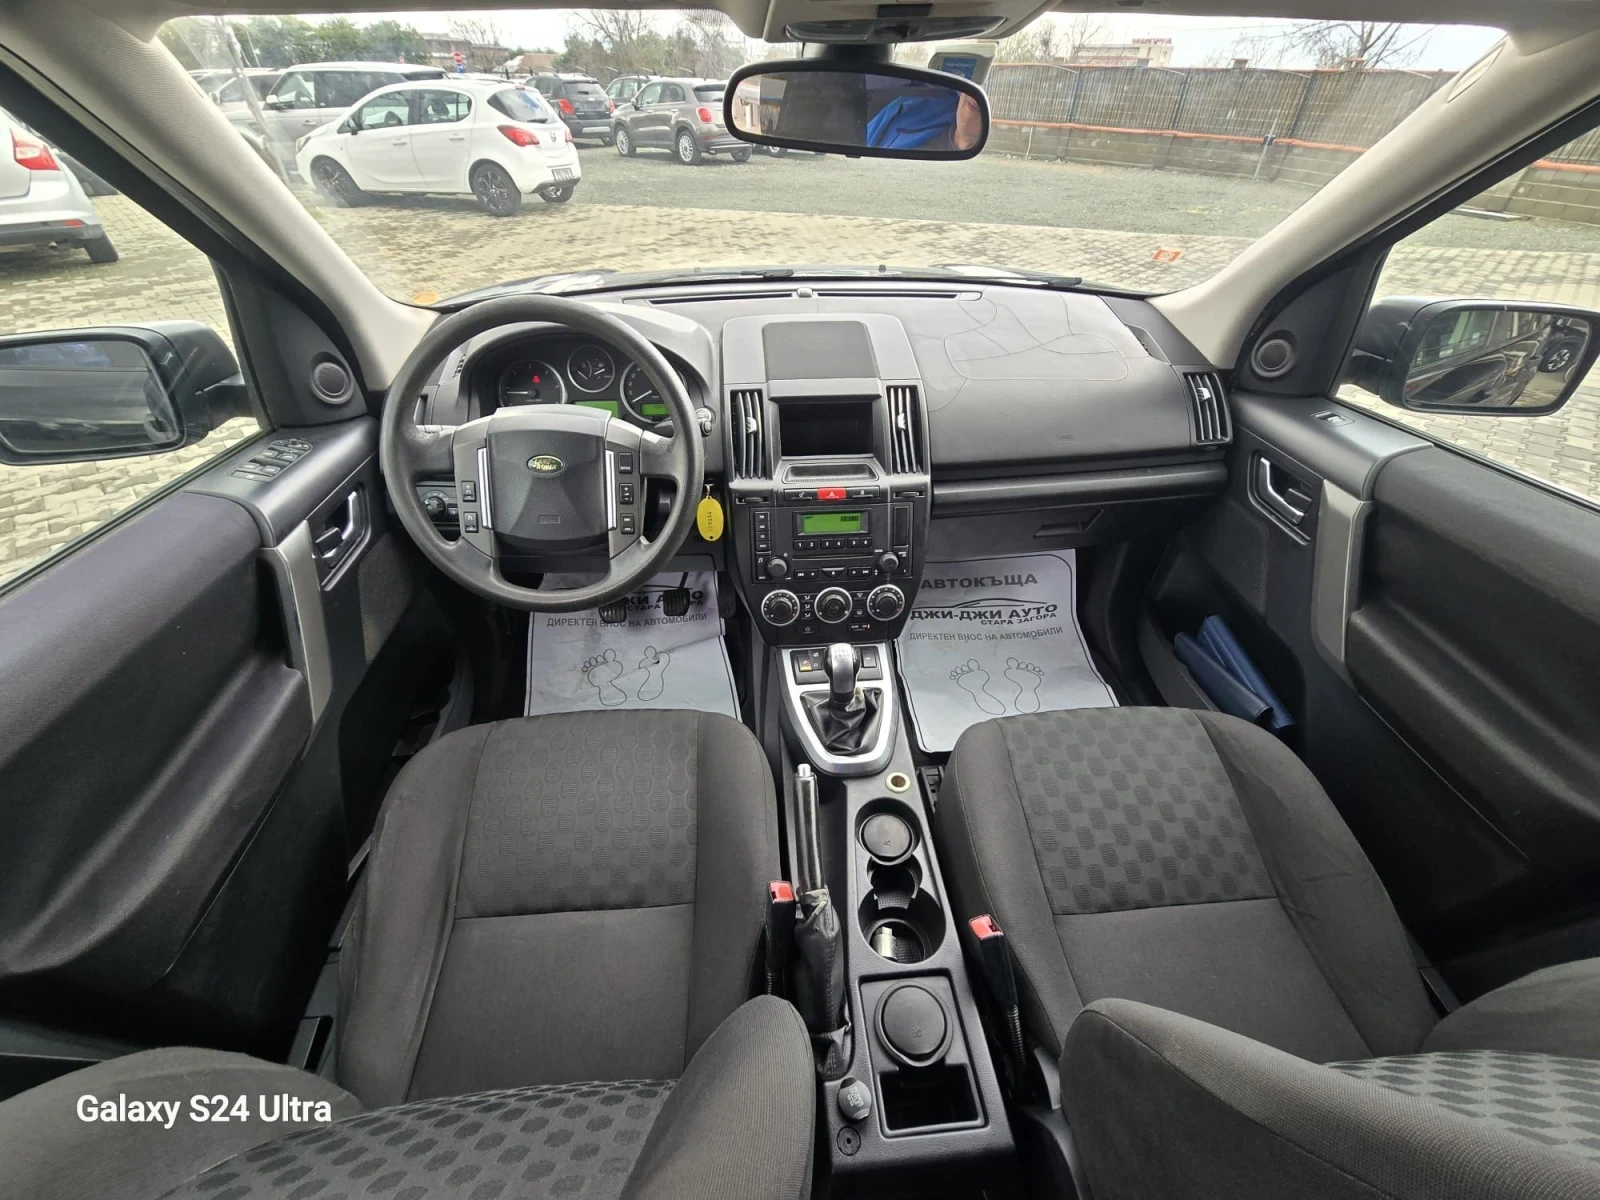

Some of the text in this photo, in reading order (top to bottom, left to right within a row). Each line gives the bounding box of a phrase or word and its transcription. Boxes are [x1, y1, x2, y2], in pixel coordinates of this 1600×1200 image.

[920, 574, 1038, 589] АВТОКЪЩА
[547, 617, 597, 627] ДИРЕКТЕН
[628, 619, 641, 628] НА
[644, 612, 707, 627] АВТОМОБИЛИ
[910, 604, 1057, 621] ДЖИ-ДЖИ АУТО
[1017, 612, 1056, 624] ЗАГОРА
[910, 626, 1063, 641] ДИРЕКТЕН ВНОС НА АВТОМОБИЛИ
